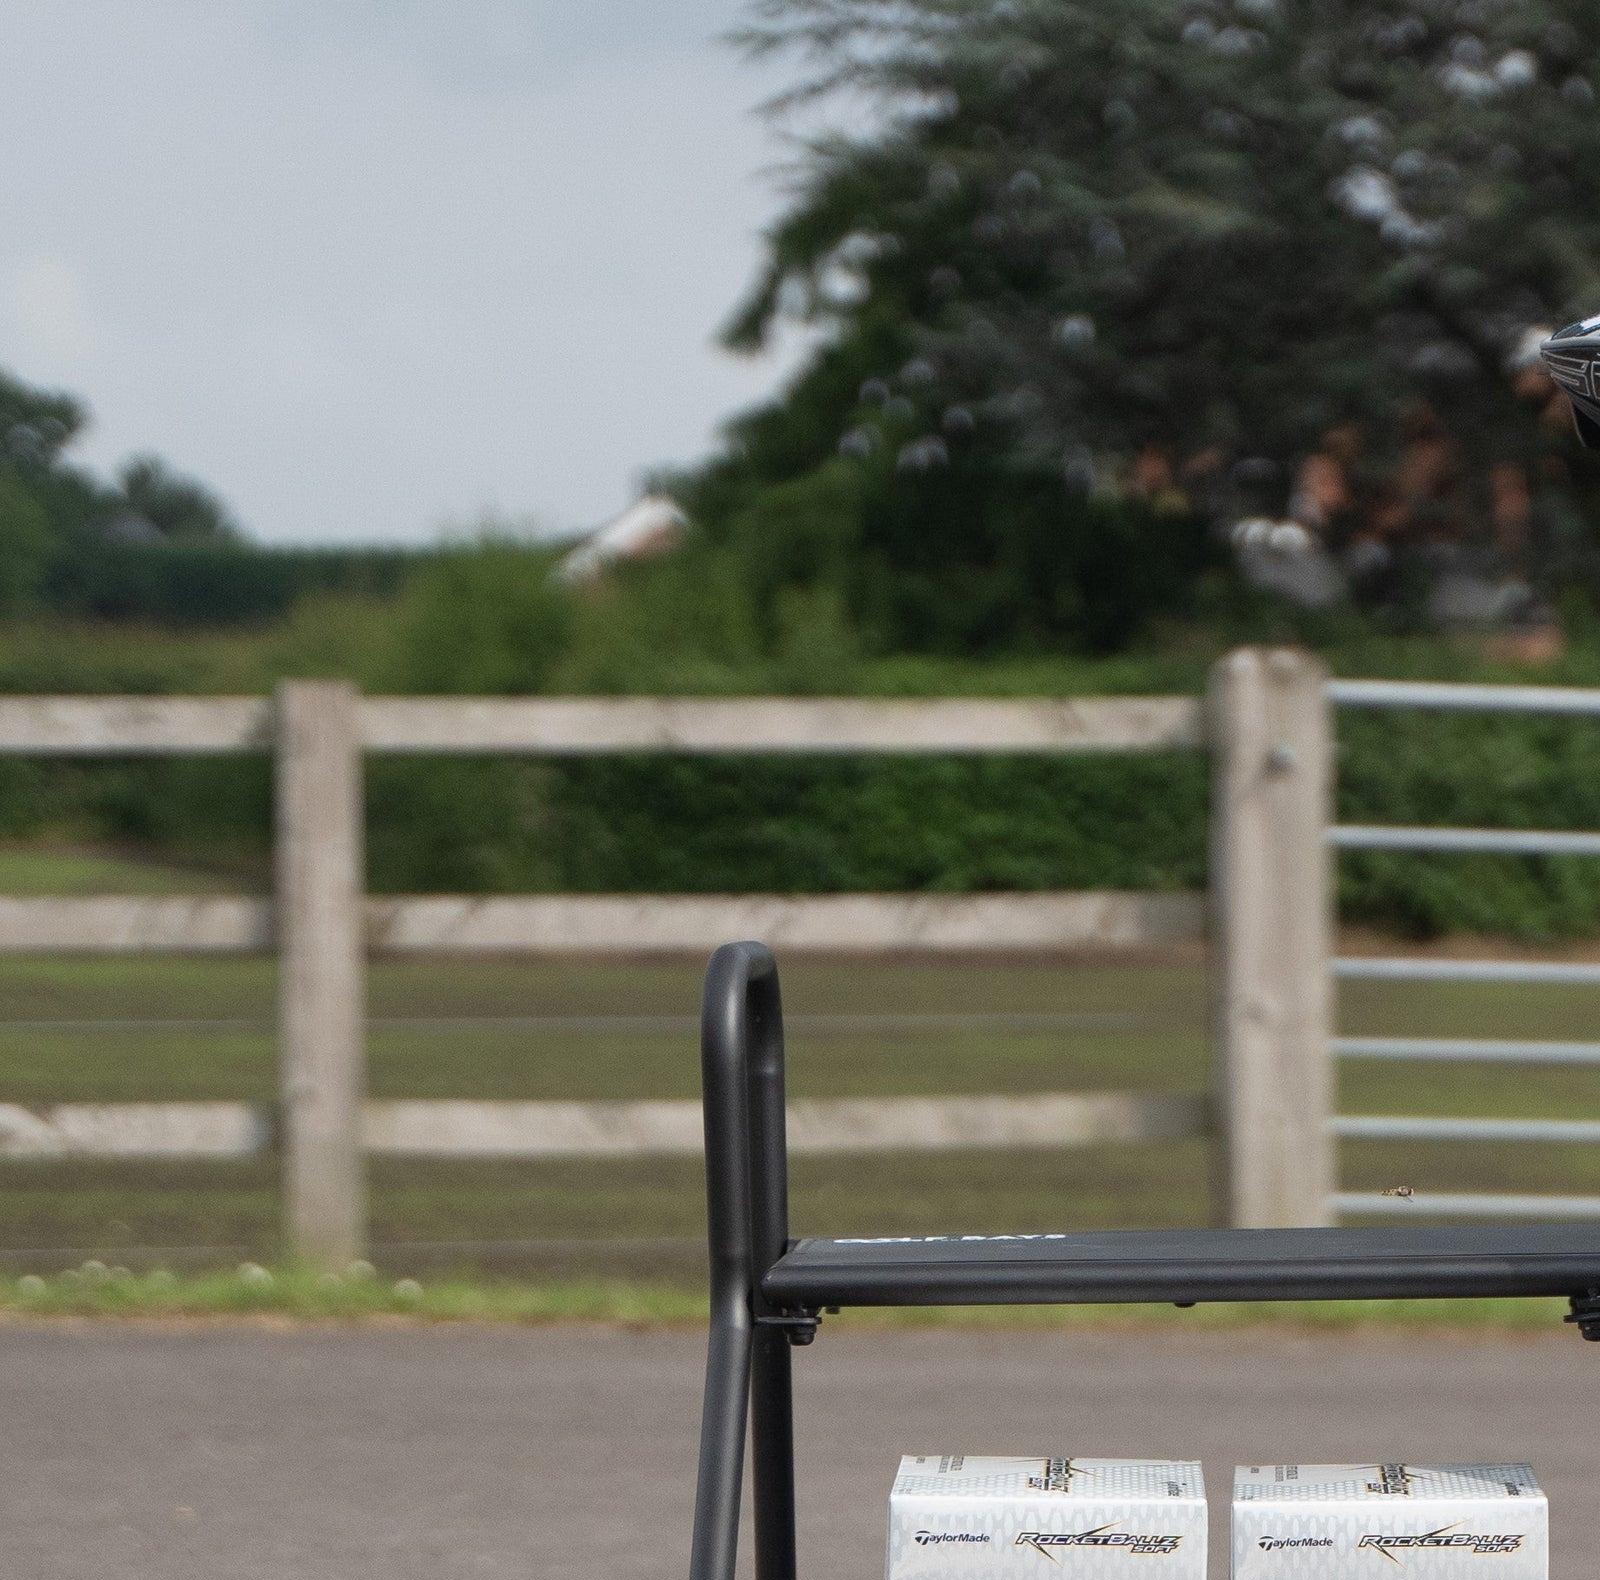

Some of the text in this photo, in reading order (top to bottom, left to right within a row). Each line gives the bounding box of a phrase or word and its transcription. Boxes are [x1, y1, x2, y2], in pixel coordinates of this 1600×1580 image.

[914, 1530, 990, 1546] TaylorMade
[1258, 1535, 1333, 1551] TaylorMade
[1131, 1544, 1179, 1554] SOFT
[1473, 1544, 1520, 1553] SOFT
